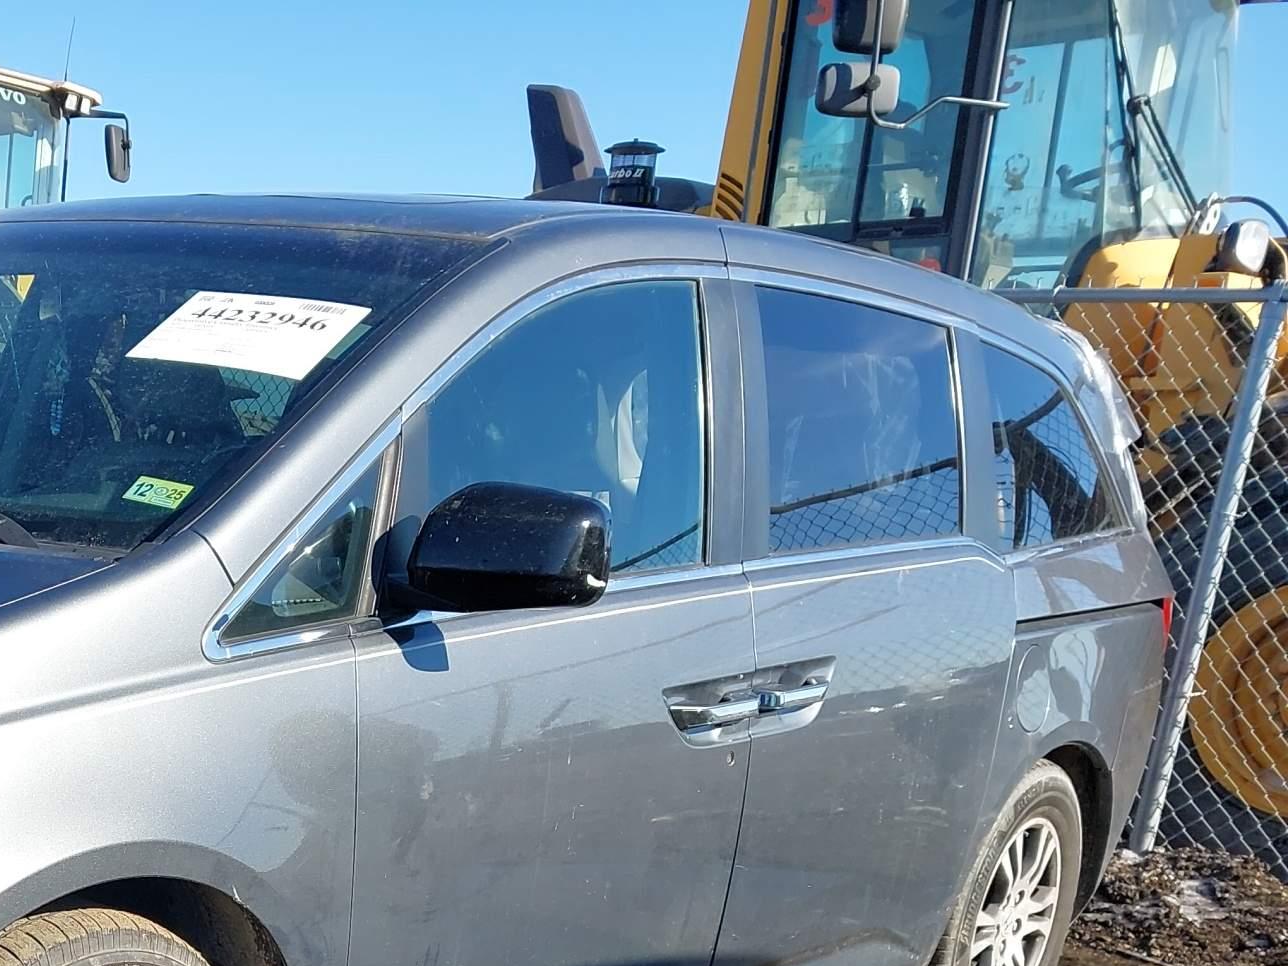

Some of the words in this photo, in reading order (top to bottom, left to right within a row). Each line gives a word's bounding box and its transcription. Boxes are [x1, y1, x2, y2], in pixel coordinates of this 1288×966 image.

[191, 306, 329, 332] 44232946
[132, 481, 155, 497] 12
[165, 488, 187, 501] 25
